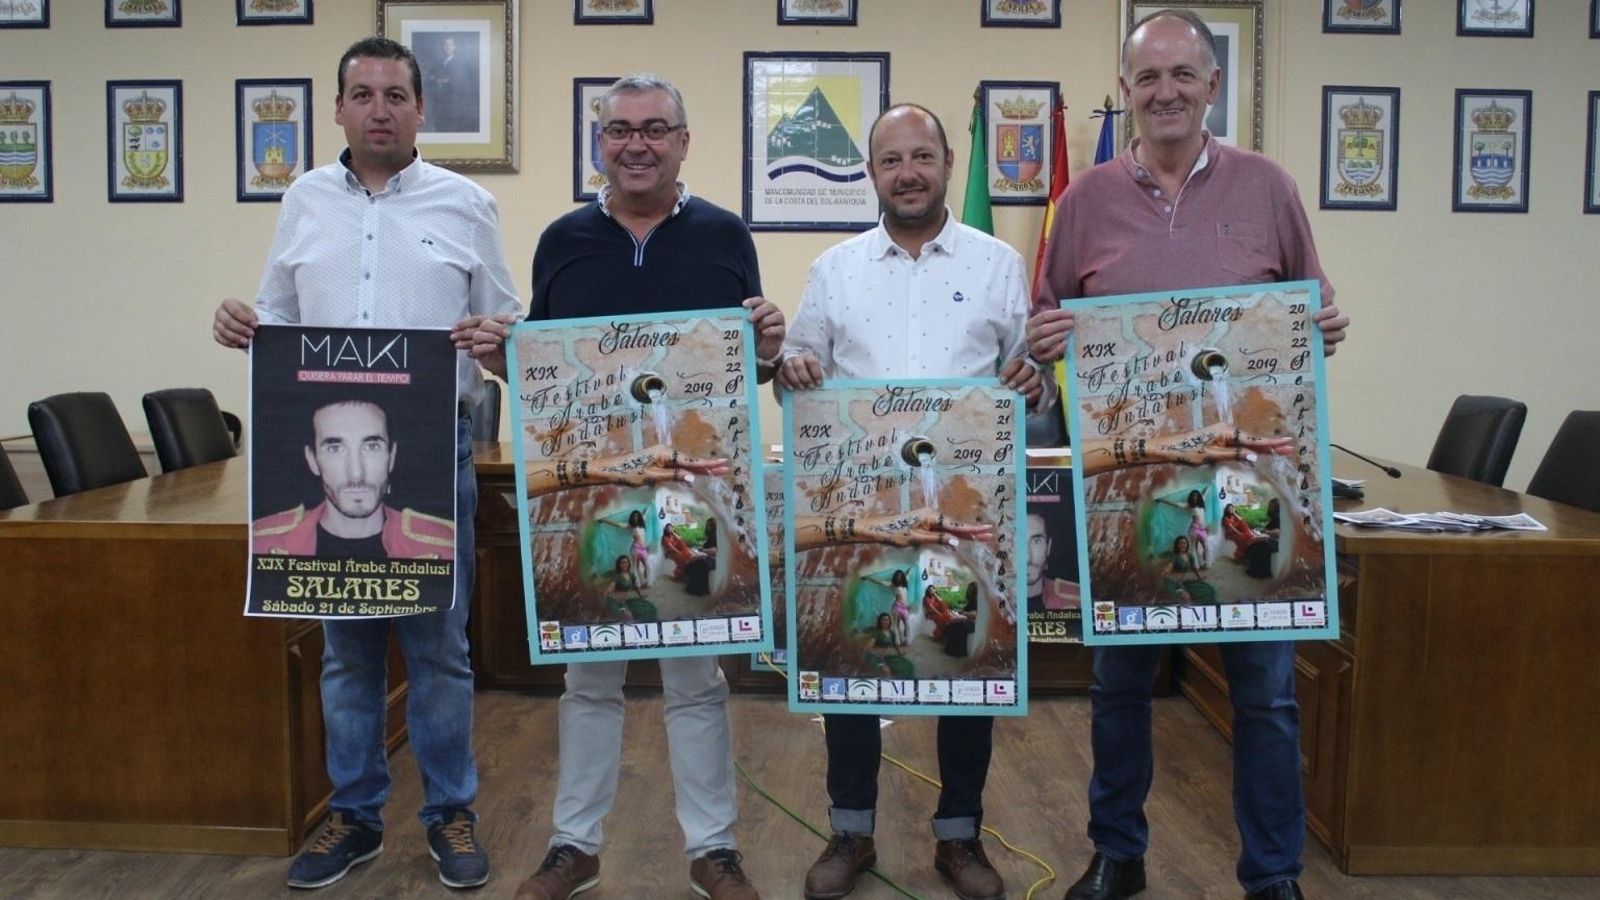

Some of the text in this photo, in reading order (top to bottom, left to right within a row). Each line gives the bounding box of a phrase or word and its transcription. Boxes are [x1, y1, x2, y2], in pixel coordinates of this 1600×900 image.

[774, 197, 783, 206] LA
[806, 197, 818, 206] DEL
[1158, 297, 1244, 330] Salares
[1289, 304, 1305, 314] 20
[1291, 320, 1305, 331] 21
[598, 321, 681, 354] Salares
[723, 330, 740, 340] 20
[1291, 337, 1308, 348] 22
[301, 333, 408, 368] MAKI
[726, 346, 740, 356] 21
[1082, 342, 1116, 358] XIX
[725, 362, 742, 373] 22
[1077, 341, 1187, 393] Festival
[1247, 358, 1278, 371] 2019
[365, 373, 375, 383] EL
[525, 365, 558, 381] XIX
[520, 364, 626, 415] Festival
[684, 382, 713, 395] 2019
[1107, 370, 1182, 408] Arabe
[872, 385, 953, 417] Salares
[995, 399, 1010, 409] 20
[550, 393, 623, 430] Arabe
[996, 415, 1010, 425] 21
[799, 424, 832, 438] XIX
[995, 431, 1012, 441] 22
[794, 427, 898, 471] Festival
[954, 450, 982, 461] 2019
[820, 455, 893, 487] Arabe
[288, 558, 341, 572] Festival
[286, 576, 420, 601] SALARES
[262, 600, 438, 616] Sábado 21 de Septiembre
